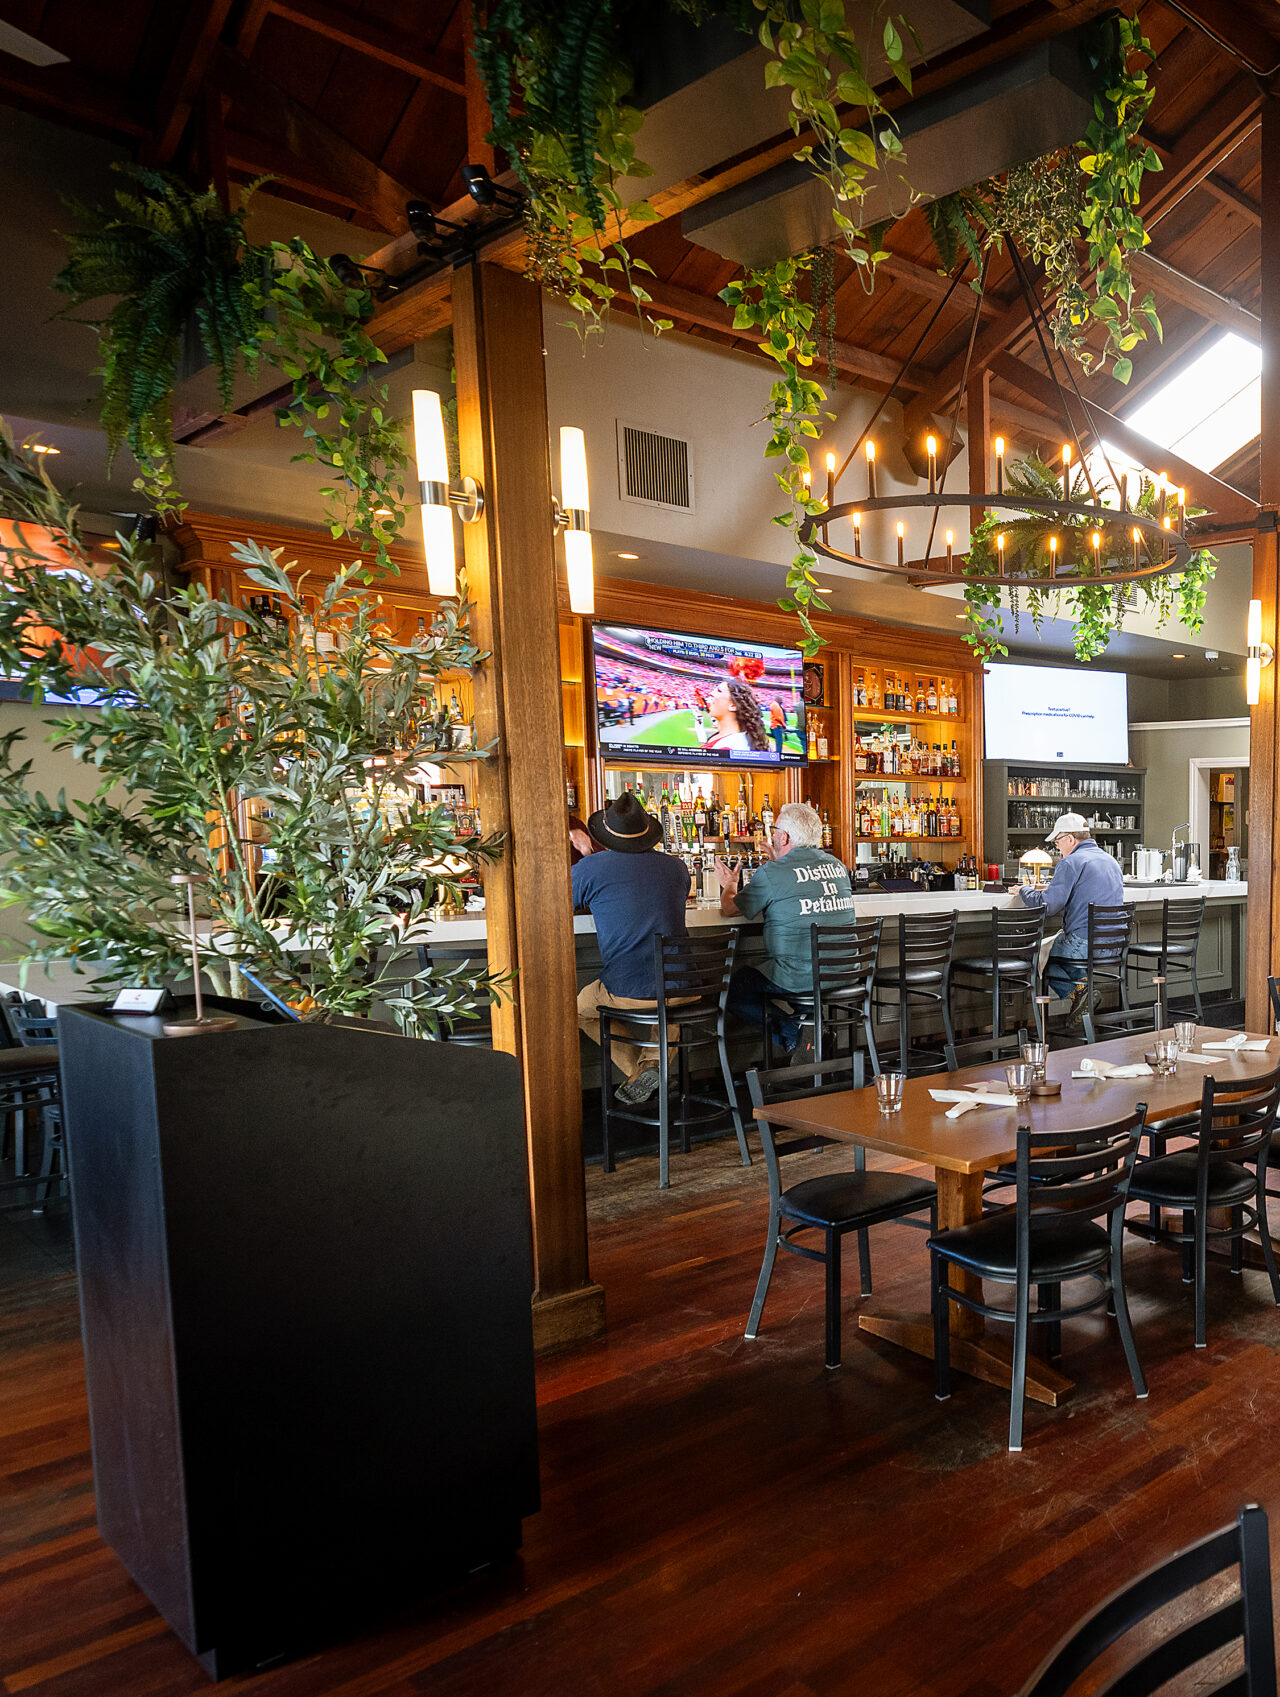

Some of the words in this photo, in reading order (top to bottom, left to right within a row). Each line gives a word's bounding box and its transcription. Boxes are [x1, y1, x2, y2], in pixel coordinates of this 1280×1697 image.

[793, 863, 847, 884] Distilled
[820, 880, 838, 896] In
[799, 895, 855, 916] Petalum
